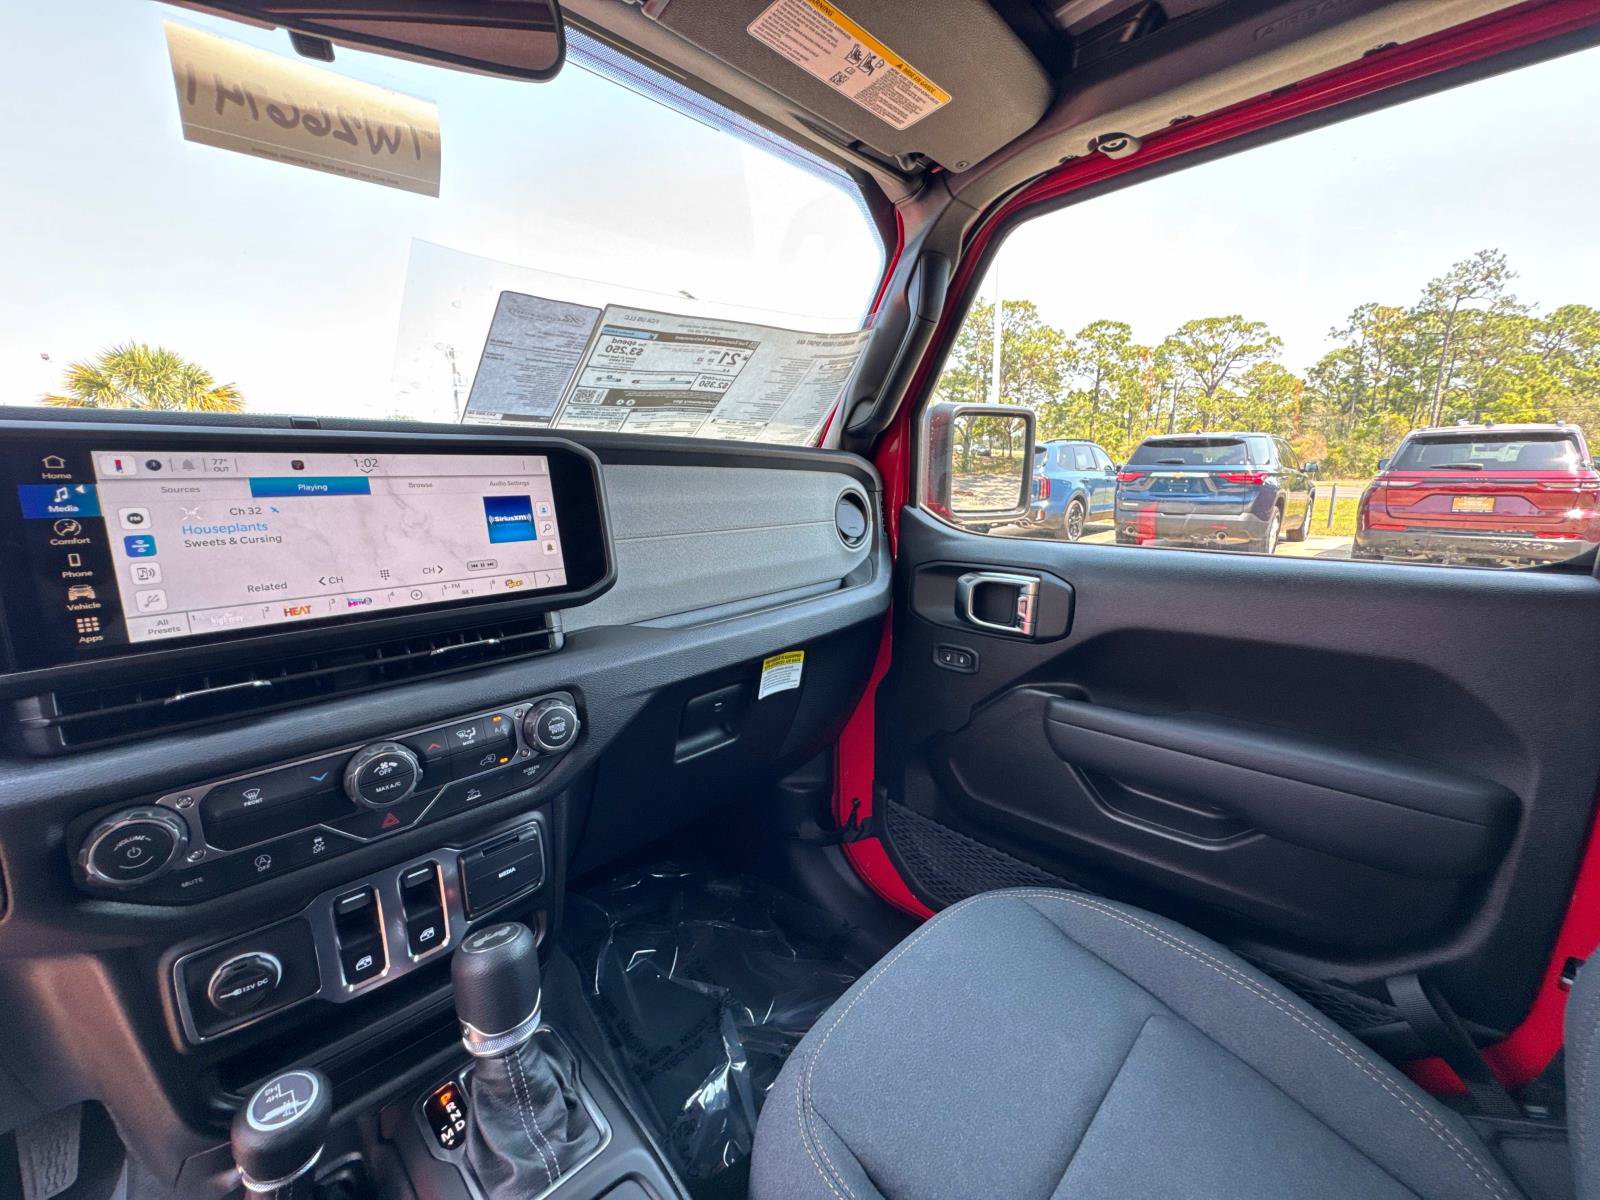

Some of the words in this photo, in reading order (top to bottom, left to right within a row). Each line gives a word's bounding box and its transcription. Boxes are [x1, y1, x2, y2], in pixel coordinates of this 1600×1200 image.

[353, 457, 379, 469] 1:02
[42, 472, 72, 480] Home
[160, 486, 201, 494] Sources
[298, 482, 328, 492] Playing
[408, 481, 433, 489] Browse
[47, 504, 79, 512] Media
[229, 507, 247, 516] Ch
[248, 506, 262, 515] 32
[182, 521, 268, 535] Houseplants
[50, 536, 91, 546] Comfort
[184, 538, 226, 548] Sweets
[229, 536, 237, 545] &
[240, 534, 282, 547] Cursing
[62, 569, 93, 579] Phone
[422, 565, 435, 575] CH
[328, 576, 344, 585] CH
[247, 581, 288, 593] Related
[66, 601, 101, 611] Vehicle
[283, 605, 312, 617] HEAT
[148, 625, 181, 635] Presets
[79, 634, 104, 644] Apps
[379, 767, 392, 776] OFF
[375, 784, 390, 792] MAX
[243, 798, 263, 807] FRONT
[313, 845, 325, 854] OFF
[257, 864, 271, 872] OFF
[498, 866, 516, 878] MEDIA
[181, 876, 204, 888] MUTE
[242, 983, 255, 992] 12V
[257, 977, 269, 987] DC
[445, 1101, 457, 1113] R
[450, 1108, 462, 1122] N
[454, 1119, 466, 1132] D
[440, 1127, 455, 1143] M
